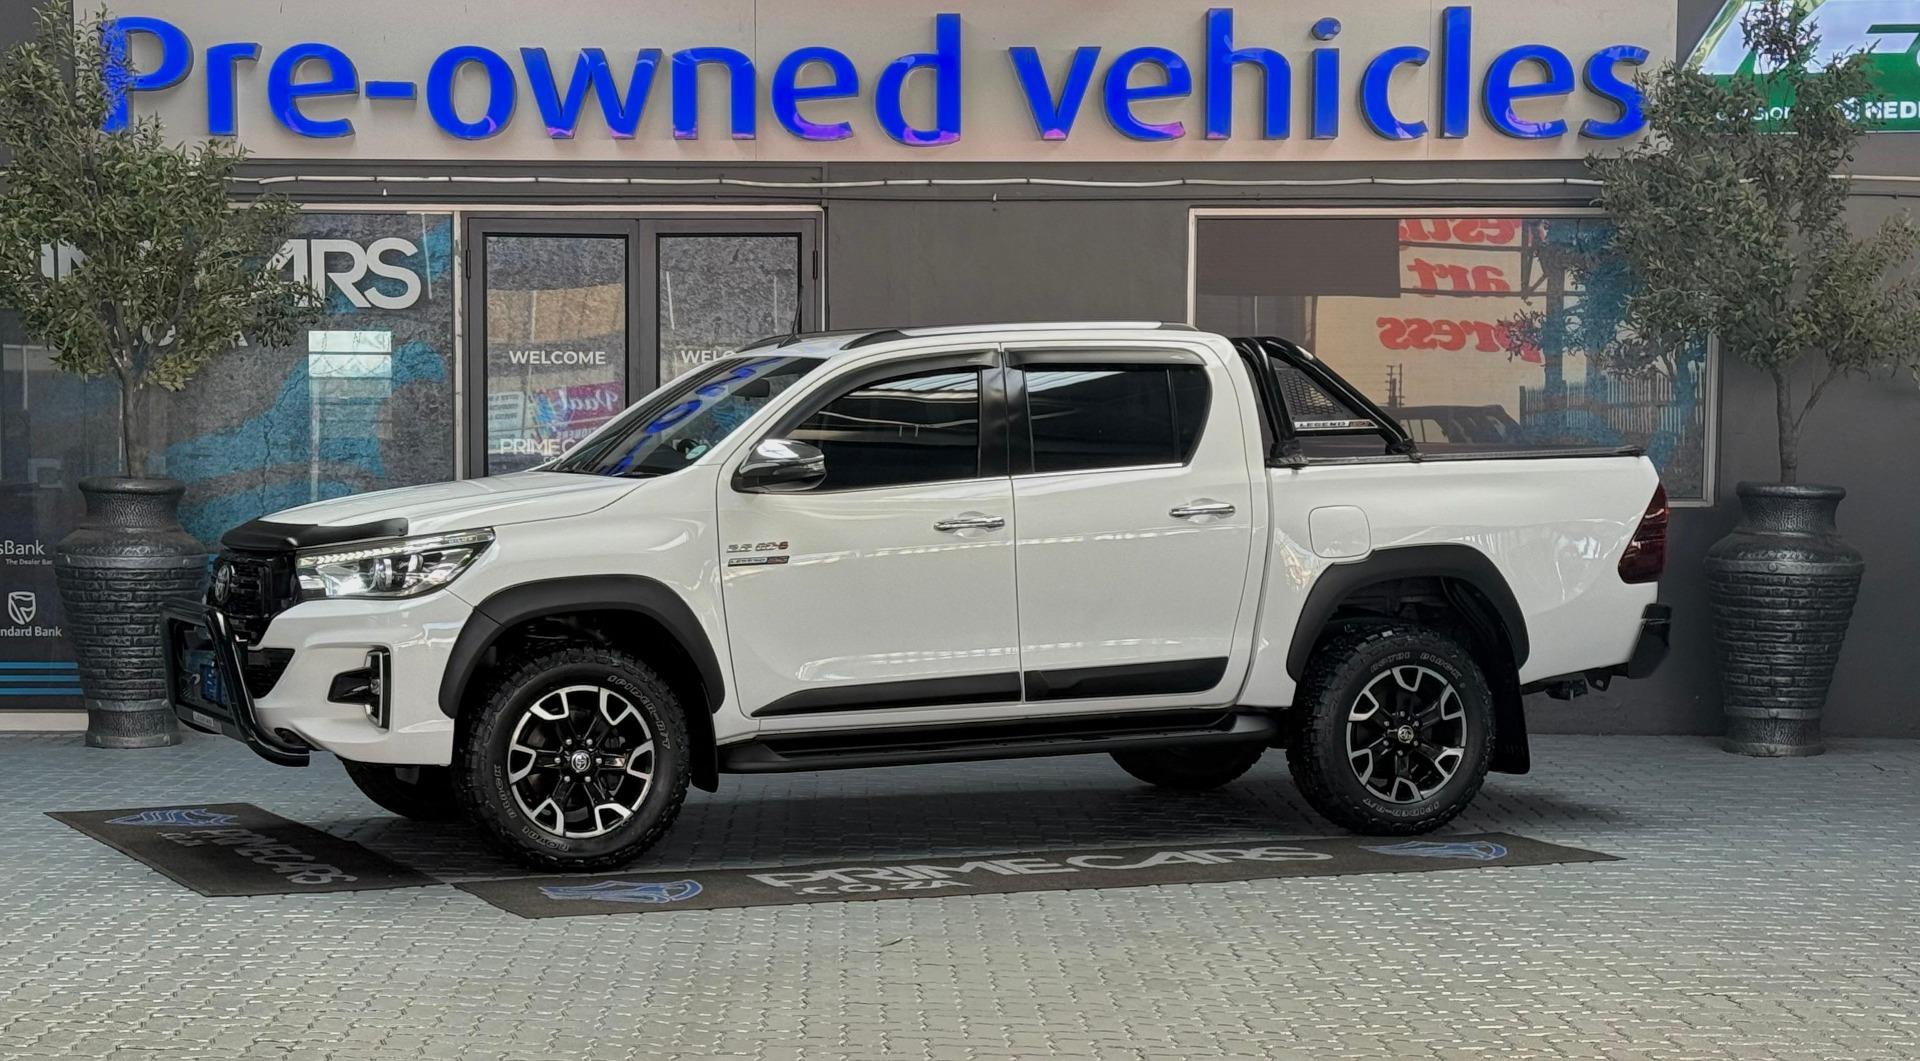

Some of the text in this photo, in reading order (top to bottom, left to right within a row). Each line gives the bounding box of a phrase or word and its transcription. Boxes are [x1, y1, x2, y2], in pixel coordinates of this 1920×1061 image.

[101, 6, 1650, 144] Pre-owned vehicles
[1865, 101, 1920, 119] NED
[508, 350, 607, 366] WELCOME
[0, 626, 63, 637] ndard Bank
[747, 846, 1333, 889] PRIMECARS
